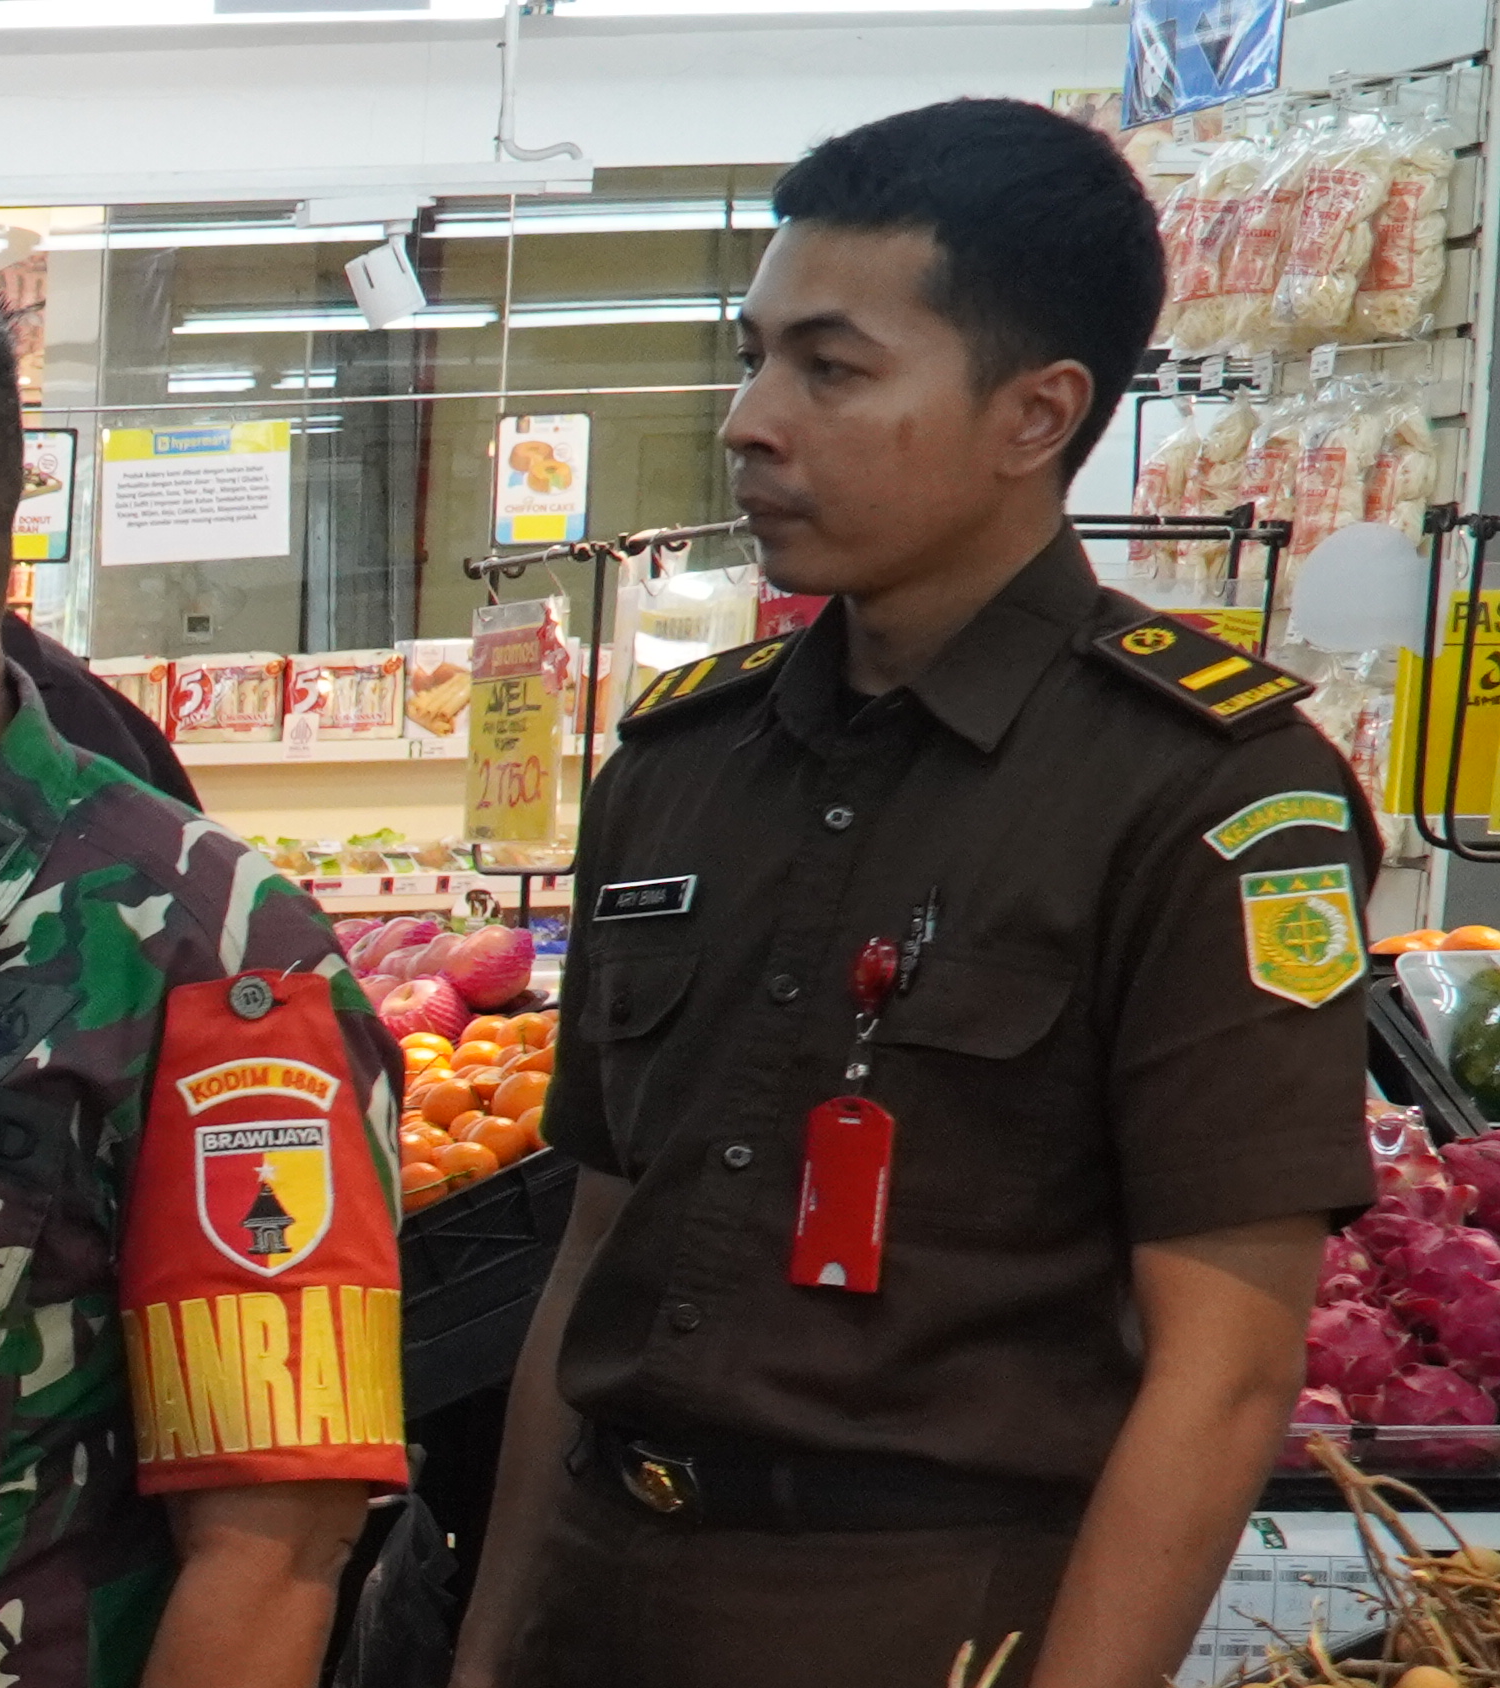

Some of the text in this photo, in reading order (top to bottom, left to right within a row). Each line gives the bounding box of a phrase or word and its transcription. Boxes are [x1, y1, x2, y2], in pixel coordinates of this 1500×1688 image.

[170, 435, 229, 451] hypermart
[504, 503, 575, 513] CHIFFON CAKE
[19, 516, 51, 526] DONUT
[180, 669, 204, 713] 5
[189, 1067, 270, 1103] KODIM
[203, 1127, 323, 1150] BRAWIJAYA
